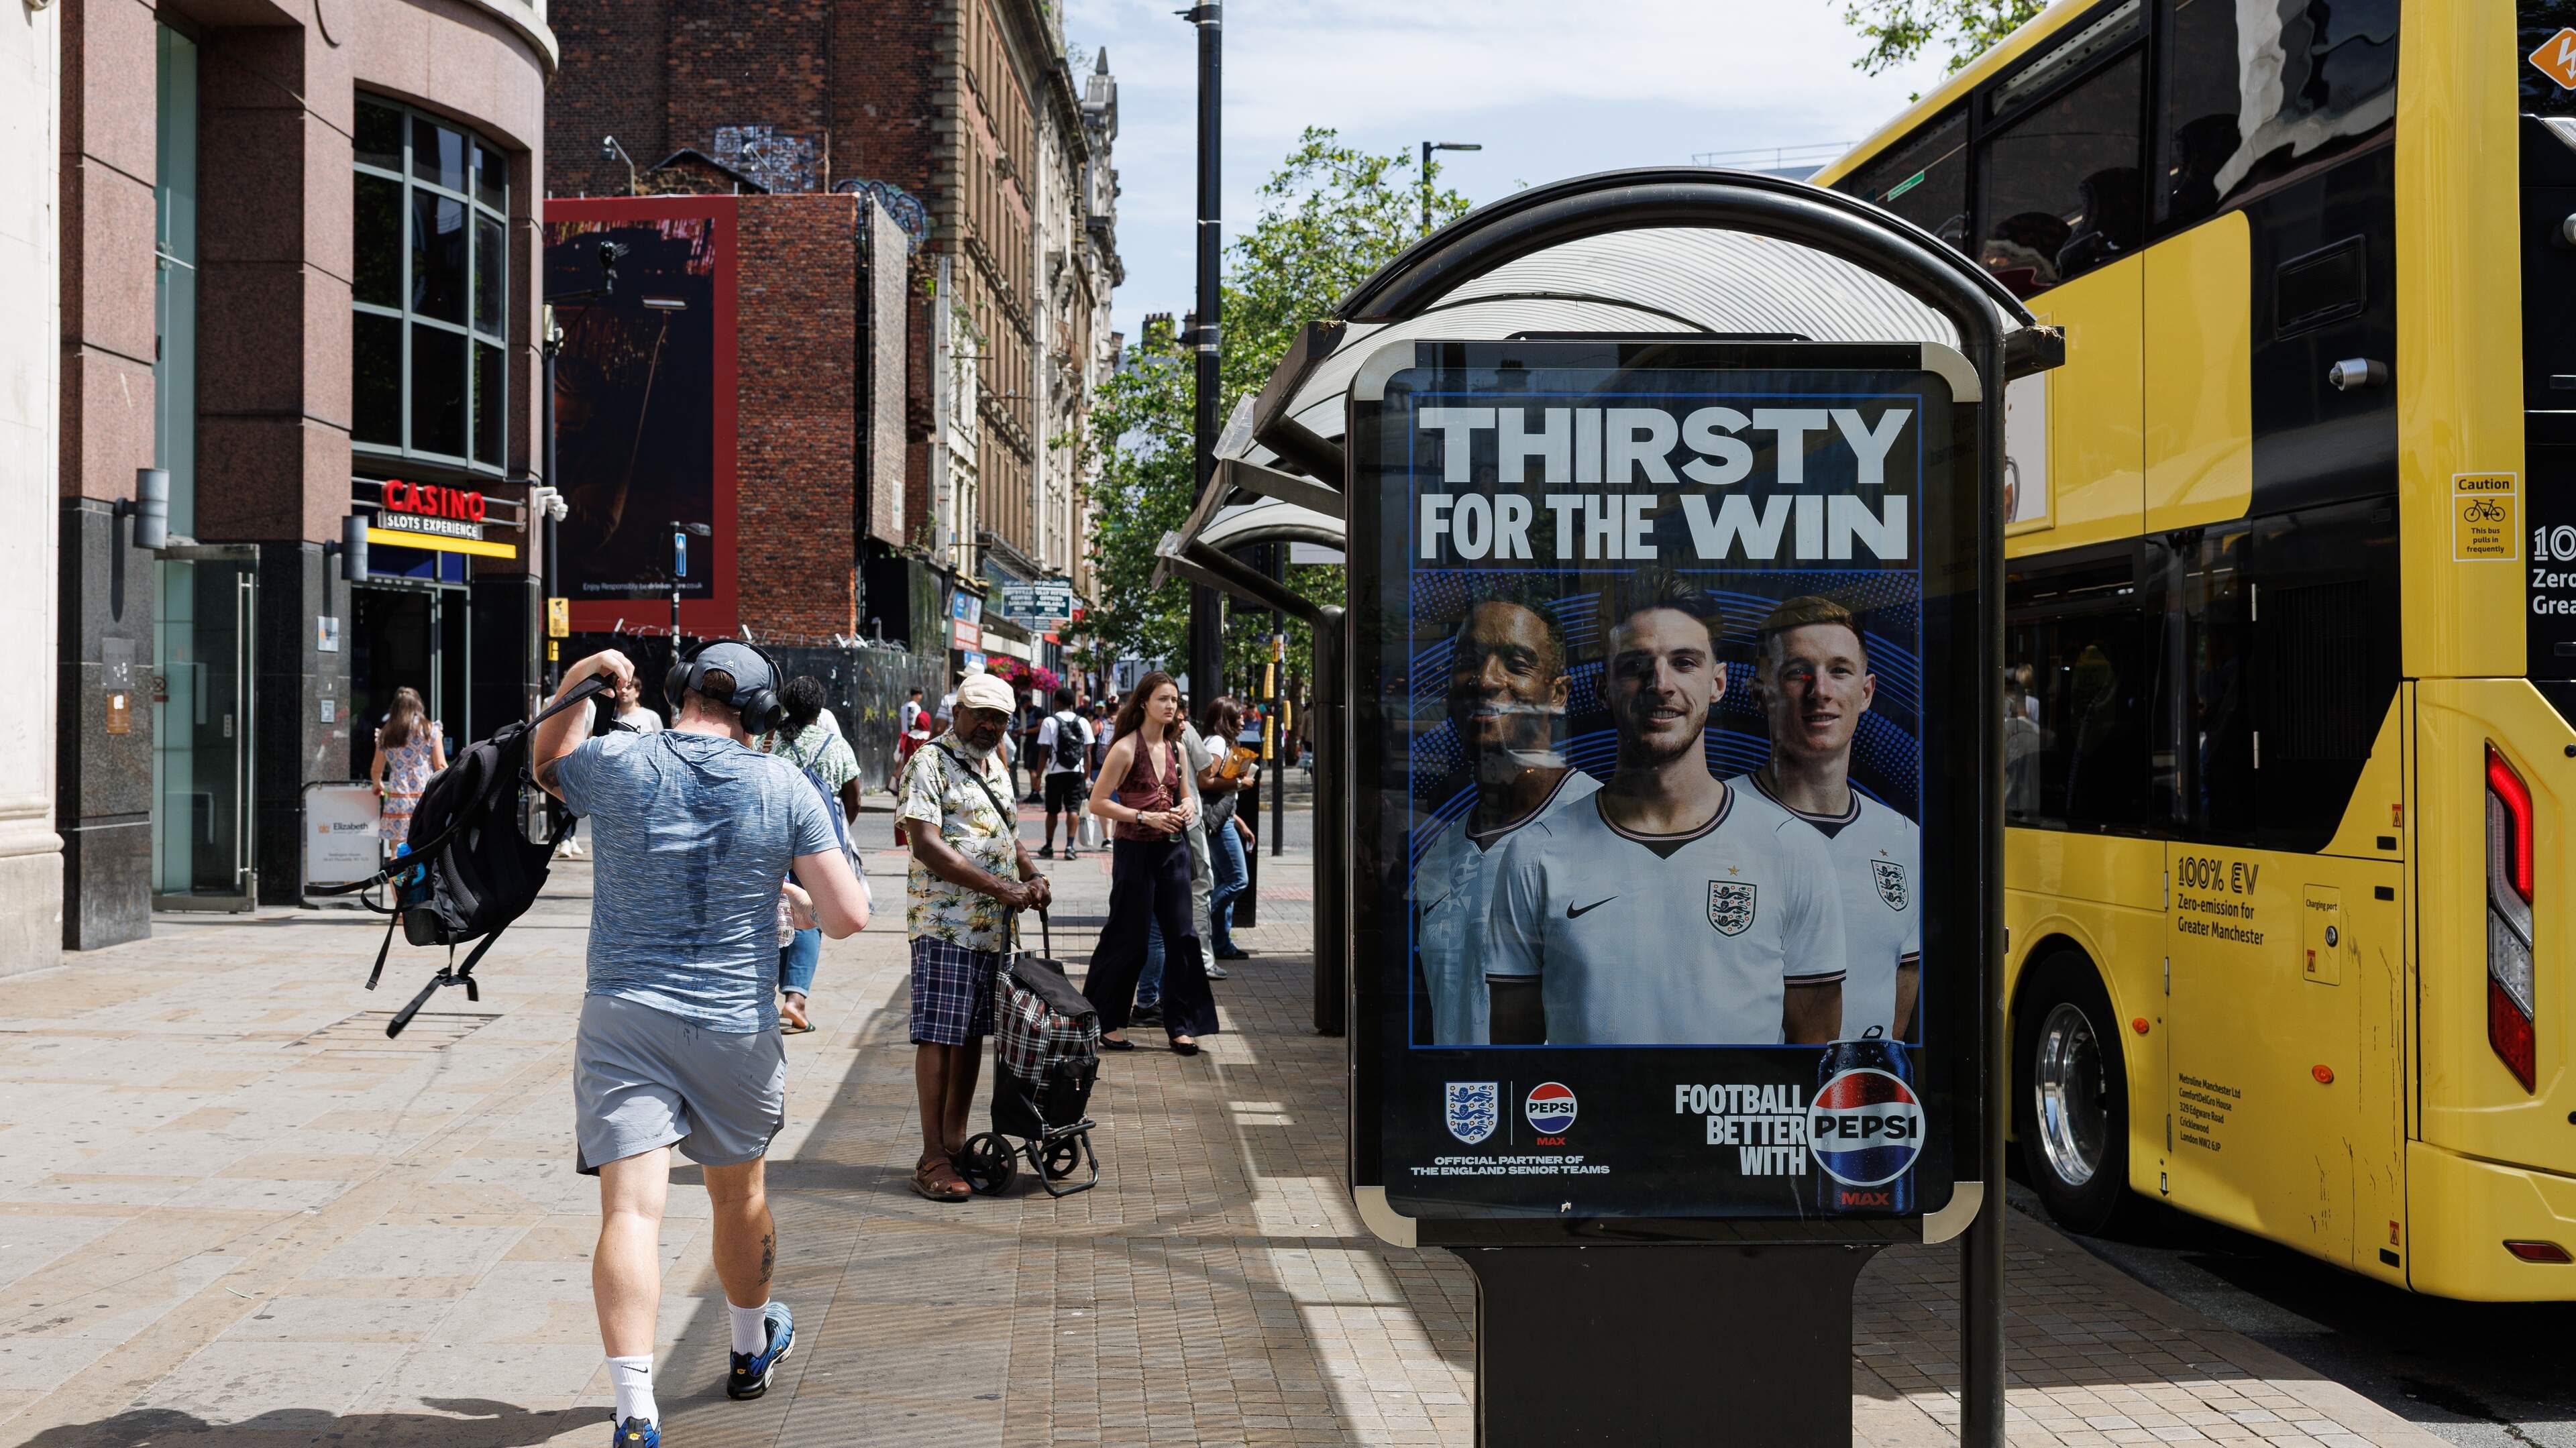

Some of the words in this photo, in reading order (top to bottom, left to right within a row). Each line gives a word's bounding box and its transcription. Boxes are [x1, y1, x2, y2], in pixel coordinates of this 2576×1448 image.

[1419, 406, 1913, 485] THIRSTY
[2458, 478, 2510, 490] Caution
[382, 480, 486, 521] CASINO
[387, 514, 420, 530] SLOTS
[423, 518, 478, 537] EXPERIENCE
[1420, 494, 1534, 559] FOR
[1545, 494, 1658, 559] THE
[1680, 494, 1908, 559] WIN
[2466, 545, 2505, 553] frequently
[2473, 536, 2490, 544] pulls
[601, 583, 638, 591] Responsibly
[333, 822, 368, 831] Elizabeth
[2178, 856, 2224, 892] 100%
[2231, 862, 2259, 895] EV
[2178, 893, 2239, 917] Zero-emission
[2241, 902, 2255, 920] for
[2306, 899, 2326, 912] Charging
[2326, 902, 2338, 912] port
[2178, 916, 2210, 937] Greater
[2211, 922, 2264, 946] Manchester
[2179, 1072, 2202, 1088] Metroline
[2202, 1079, 2231, 1096] Manchester
[2232, 1087, 2241, 1099] Ltd
[1528, 1102, 1574, 1113] PEPSI
[1675, 1084, 1807, 1114] FOOTBALL
[2179, 1087, 2216, 1107] ComfortDelGro
[2216, 1098, 2232, 1111] House
[2179, 1102, 2190, 1113] 329
[2190, 1105, 2211, 1120] Edgware
[2211, 1111, 2224, 1124] Road
[1707, 1115, 1806, 1145] BETTER
[1814, 1115, 1917, 1139] PEPSI
[2180, 1116, 2209, 1134] Cricklewood
[1536, 1137, 1566, 1146] MAX
[2180, 1130, 2198, 1145] London
[2198, 1137, 2211, 1150] NW2
[2211, 1141, 2221, 1152] 6JP
[1410, 1166, 1439, 1176] THE
[1440, 1166, 1506, 1176] ENGLAND
[1507, 1166, 1558, 1175] SENIOR
[1560, 1165, 1611, 1174] TEAMS
[1434, 1156, 1497, 1166] OFFICIAL
[1498, 1156, 1563, 1165] PARTNER
[1564, 1155, 1584, 1164] OF
[1739, 1146, 1807, 1176] WITH
[1841, 1192, 1890, 1206] MAX
